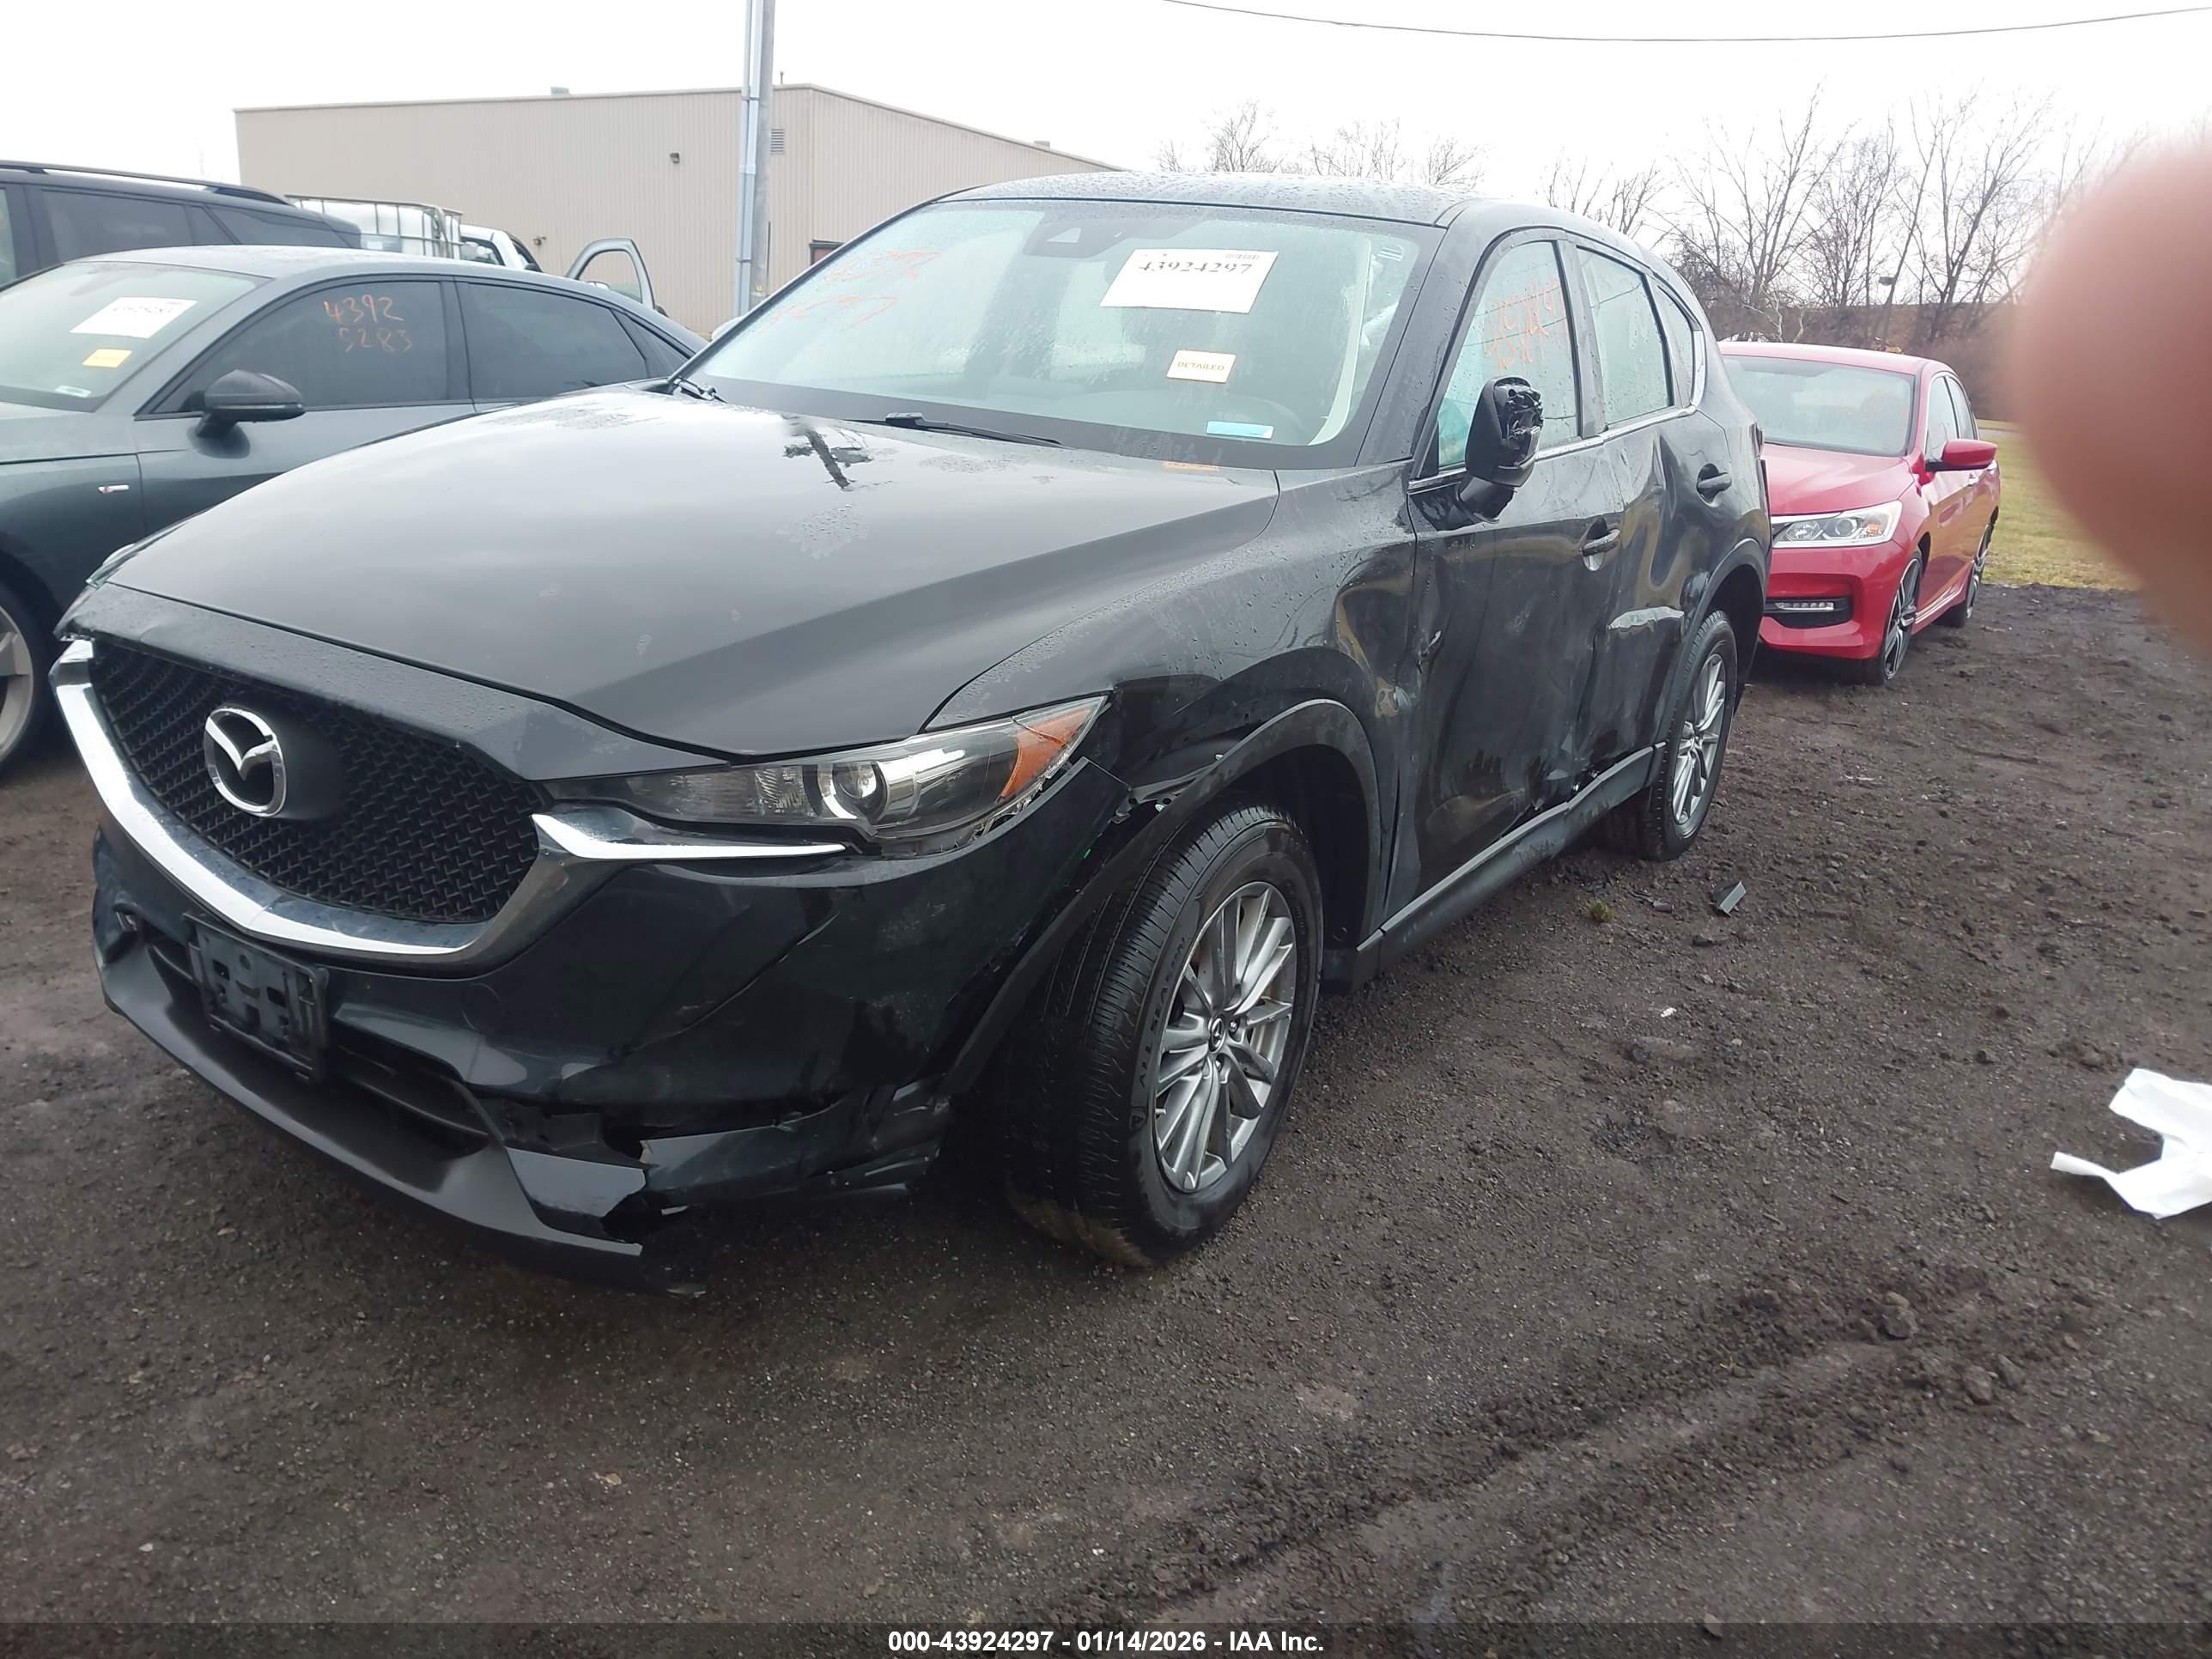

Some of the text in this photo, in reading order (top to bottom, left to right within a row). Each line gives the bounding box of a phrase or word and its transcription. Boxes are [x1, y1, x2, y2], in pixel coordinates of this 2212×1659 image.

[1138, 260, 1253, 274] 43924297
[323, 294, 404, 325] 4392
[1176, 361, 1225, 372] DETAILED
